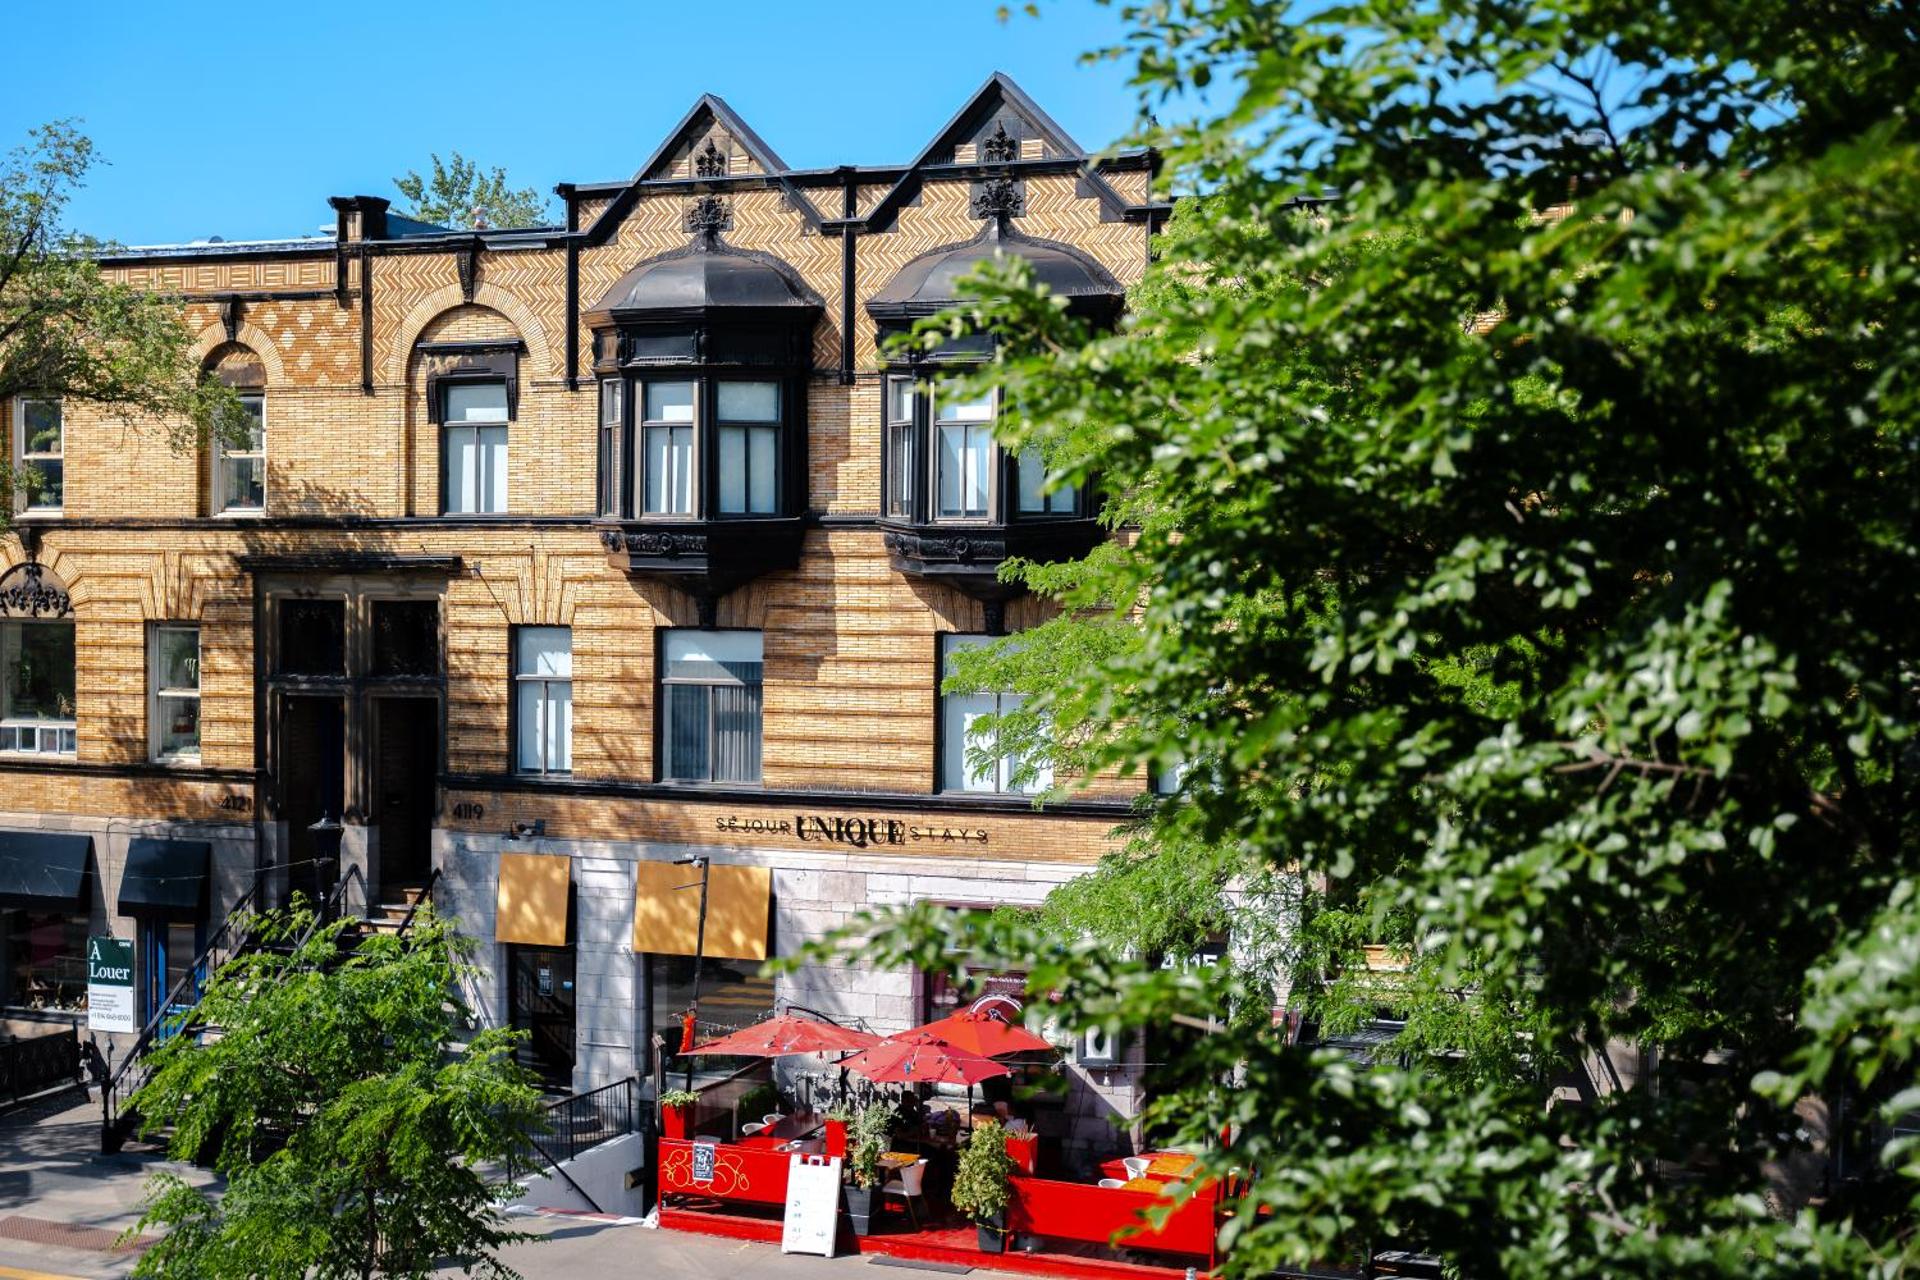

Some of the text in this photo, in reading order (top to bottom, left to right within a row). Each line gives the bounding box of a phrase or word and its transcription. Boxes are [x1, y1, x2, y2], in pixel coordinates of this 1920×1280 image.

[453, 803, 483, 820] 4119
[716, 815, 988, 848] SÉJOUR UNIQUE STAYS
[90, 941, 101, 960] À
[90, 962, 130, 980] Louer
